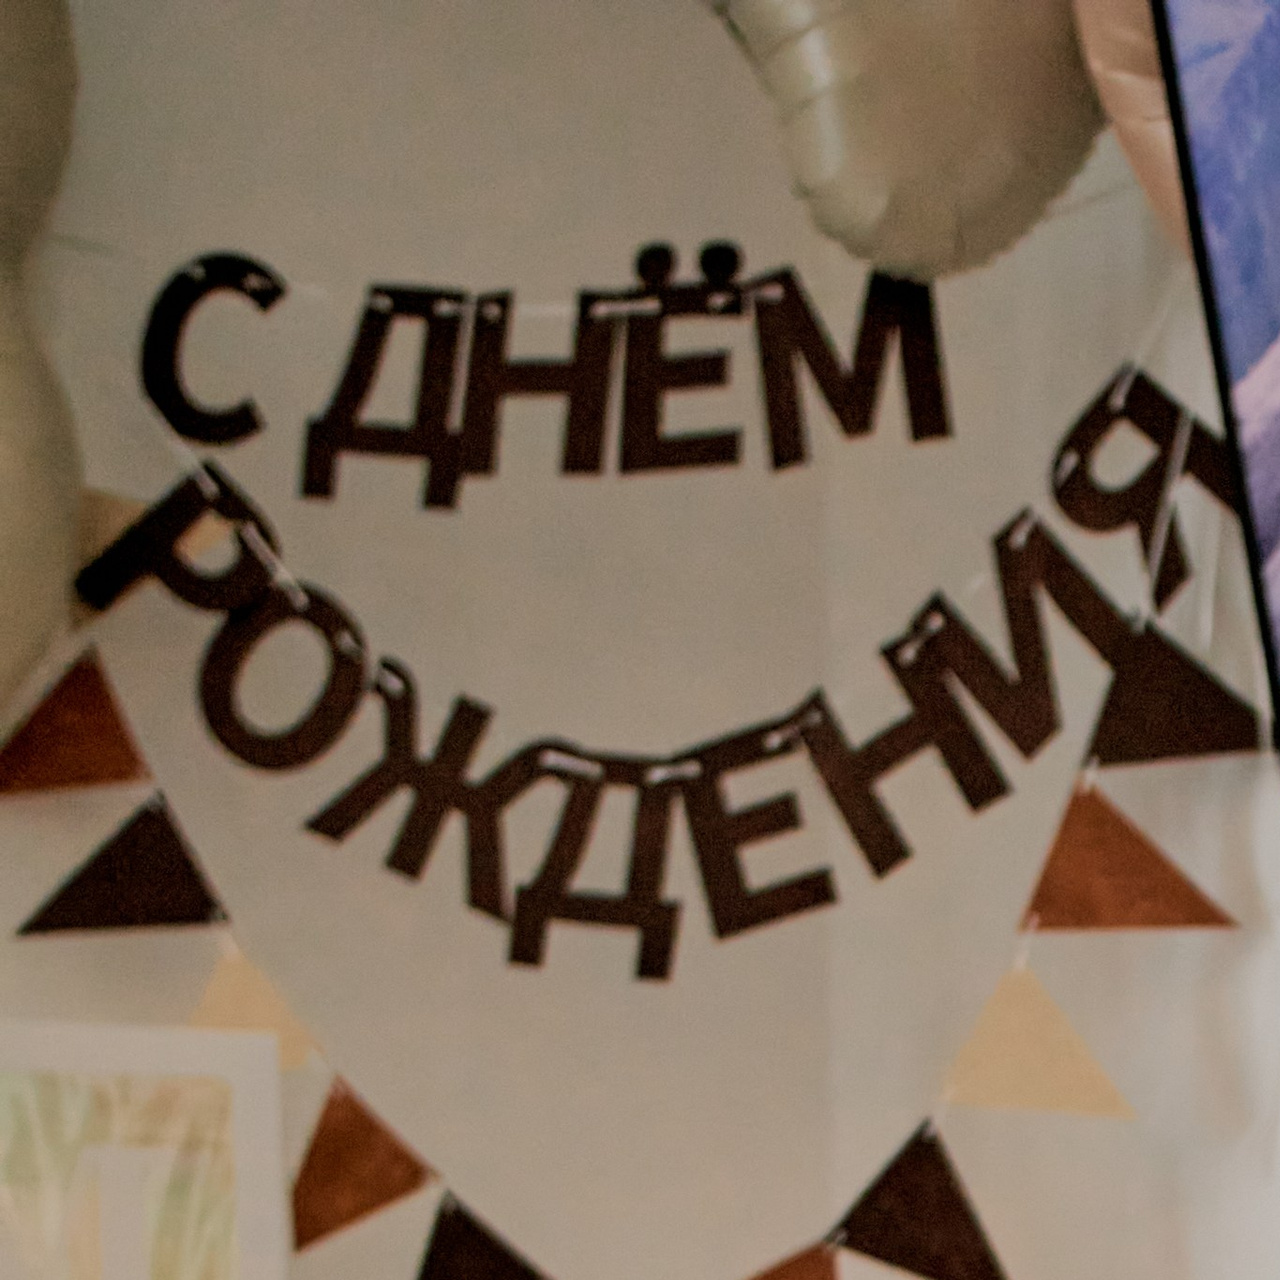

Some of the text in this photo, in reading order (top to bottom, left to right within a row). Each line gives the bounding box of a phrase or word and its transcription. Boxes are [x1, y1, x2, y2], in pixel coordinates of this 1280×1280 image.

[141, 241, 954, 509] С ДНЁМ
[76, 363, 1243, 982] РОЖДЕНИЯ
